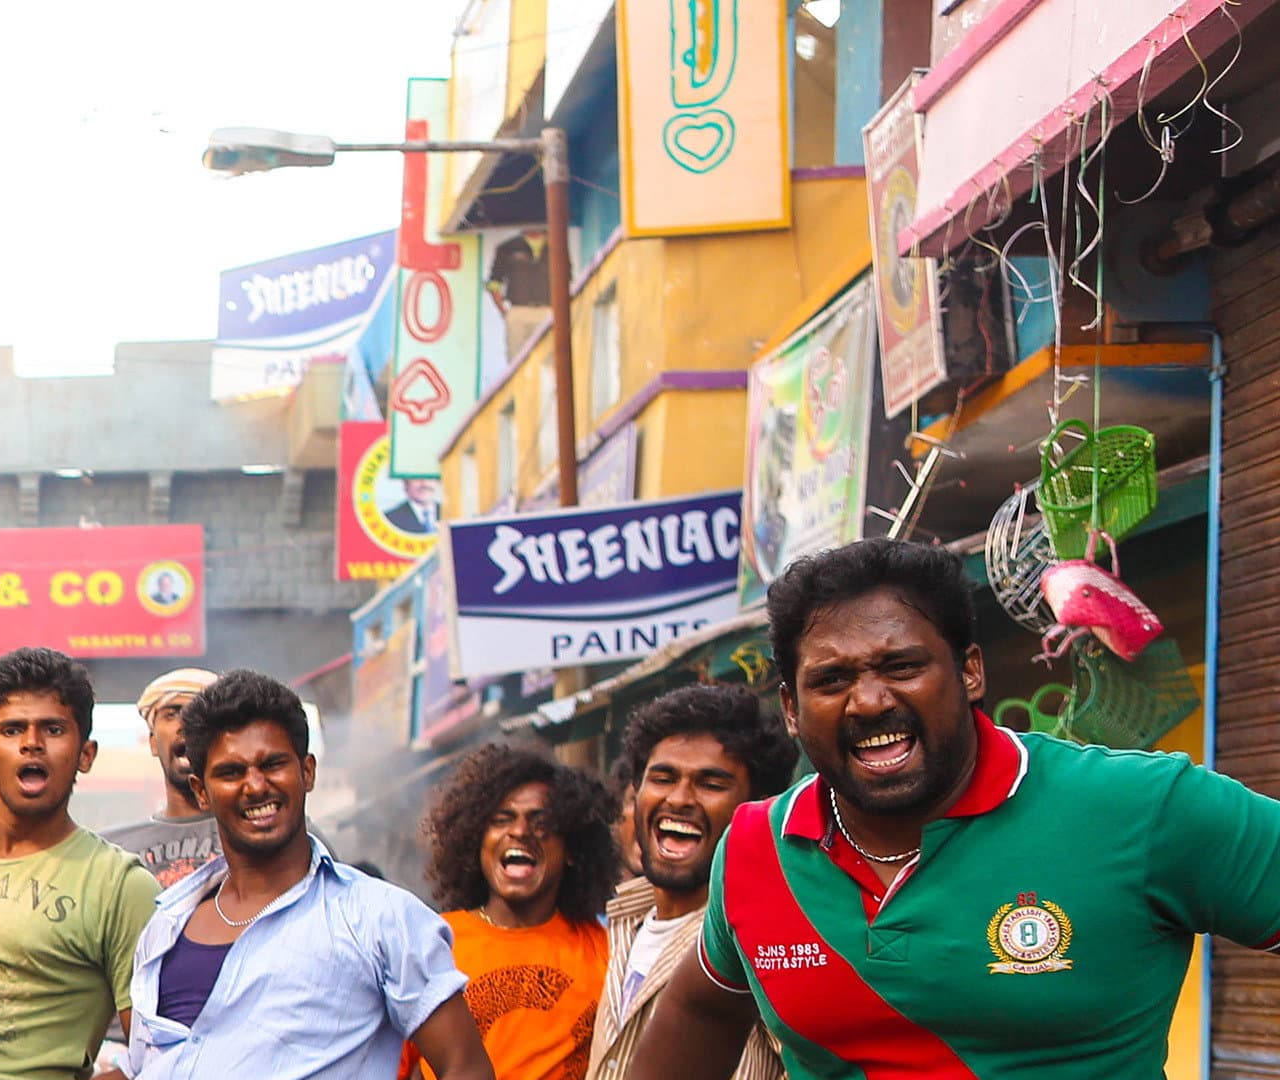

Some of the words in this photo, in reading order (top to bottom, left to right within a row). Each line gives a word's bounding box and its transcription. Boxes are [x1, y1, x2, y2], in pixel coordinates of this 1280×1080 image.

[488, 507, 740, 595] SHEENLAC
[49, 570, 124, 606] CO
[1016, 891, 1037, 907] 83
[757, 944, 786, 958] SJNS
[1012, 962, 1051, 973] CASUAL
